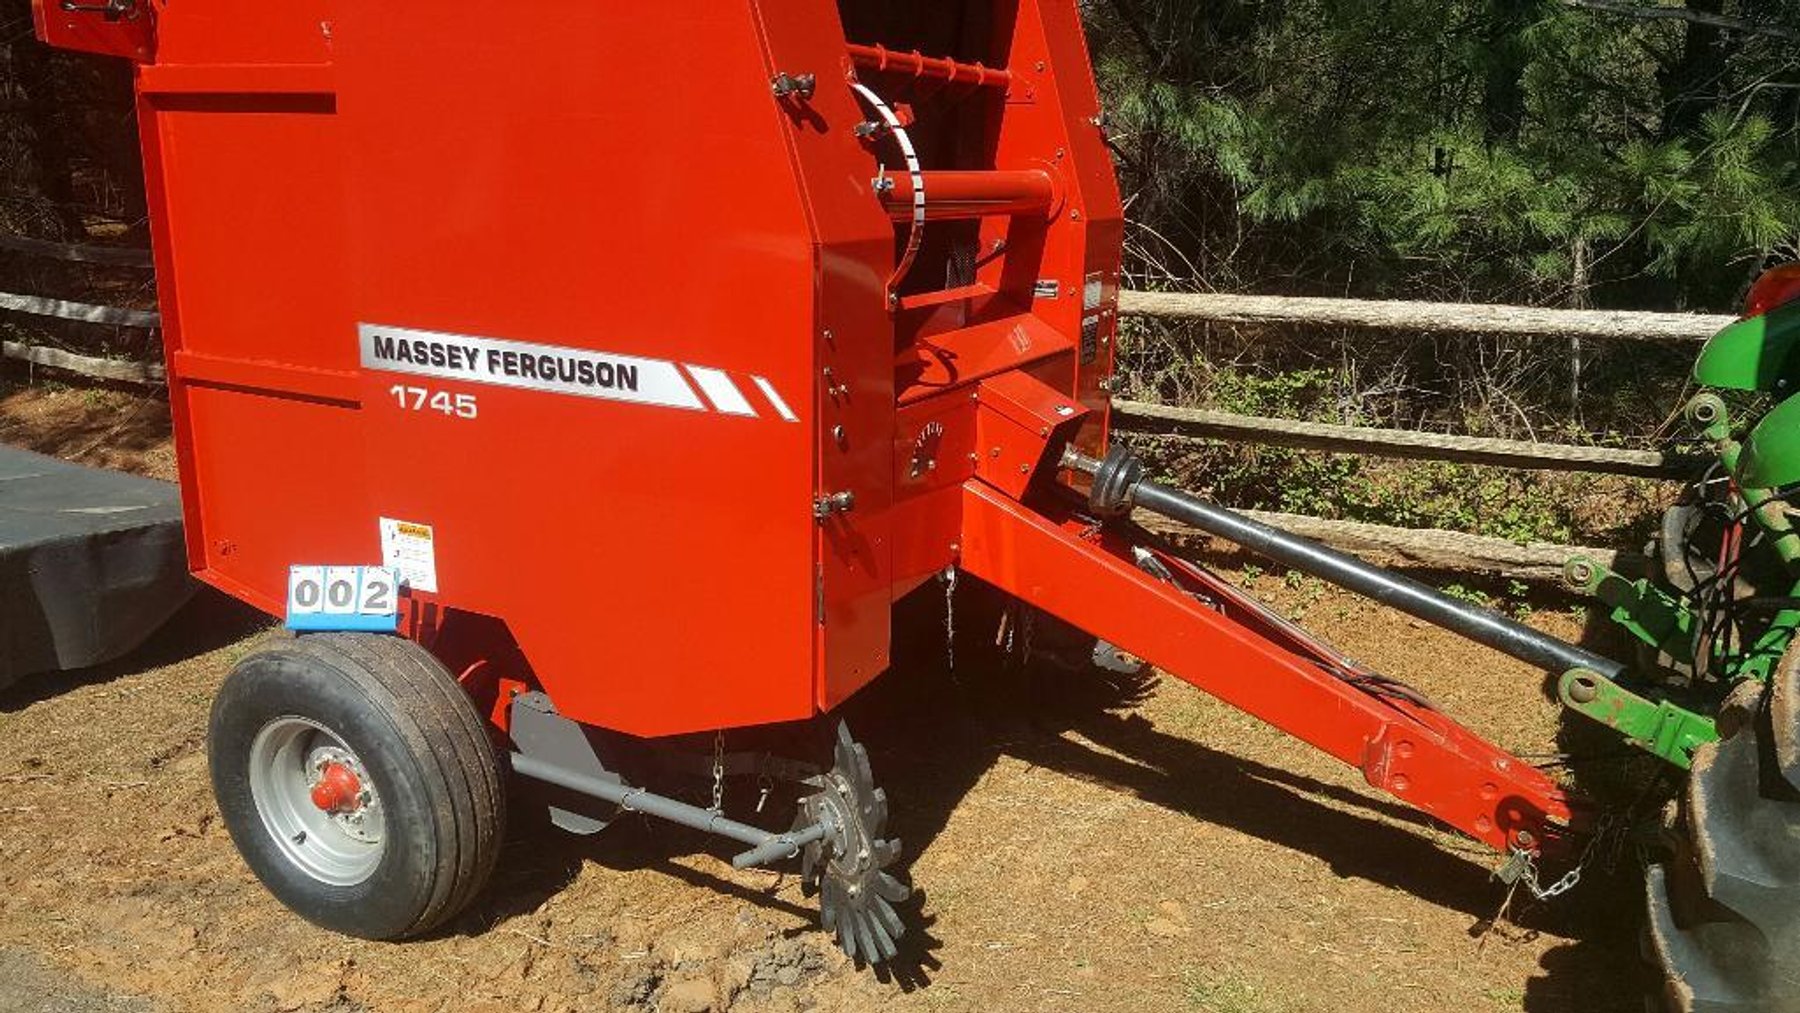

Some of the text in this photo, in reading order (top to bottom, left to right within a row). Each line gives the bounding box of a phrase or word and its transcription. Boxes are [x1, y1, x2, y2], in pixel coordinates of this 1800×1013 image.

[373, 335, 639, 391] MASSEY FERGUSON
[390, 385, 477, 419] 1745
[295, 579, 389, 609] 002
